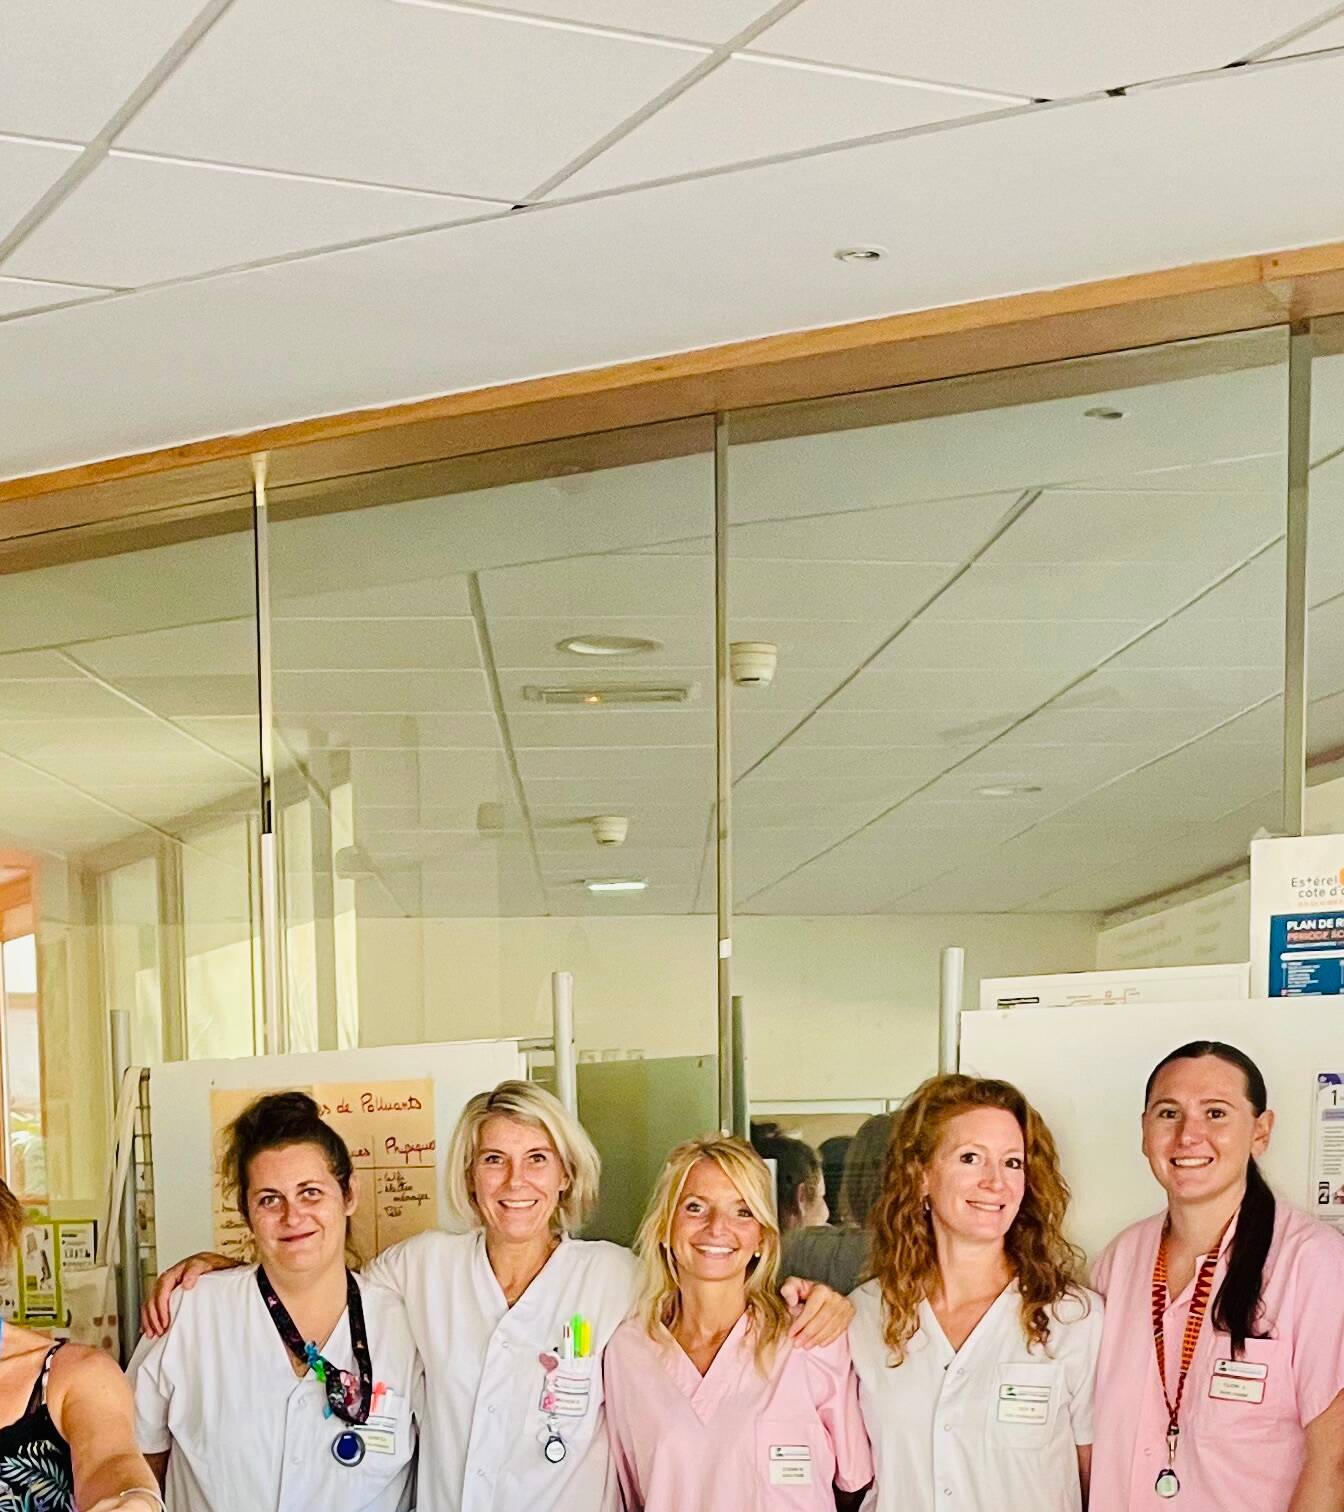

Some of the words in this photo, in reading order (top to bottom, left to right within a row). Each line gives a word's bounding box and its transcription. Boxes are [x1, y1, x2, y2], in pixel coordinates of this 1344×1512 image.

[1286, 920, 1317, 931] PLAN
[1318, 918, 1334, 929] DE
[1331, 1089, 1338, 1106] 1
